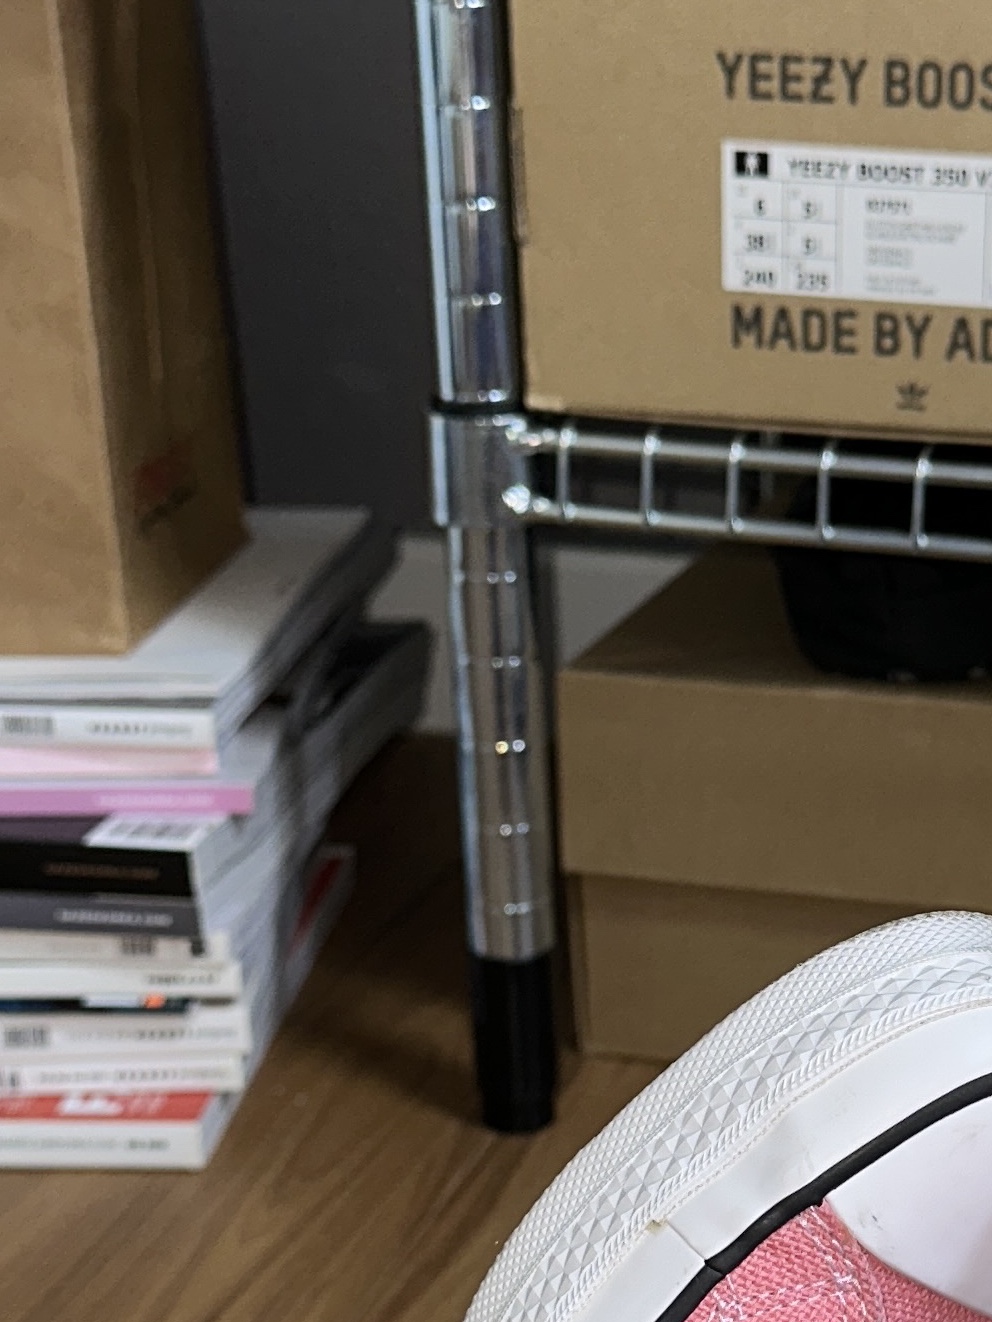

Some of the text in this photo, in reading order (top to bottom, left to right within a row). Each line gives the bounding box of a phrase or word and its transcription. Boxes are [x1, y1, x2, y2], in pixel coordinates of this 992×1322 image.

[716, 51, 868, 105] YEEZY
[787, 158, 852, 179] YEEZY
[857, 162, 924, 184] BOOST
[731, 304, 858, 355] MADE
[873, 312, 932, 360] BY
